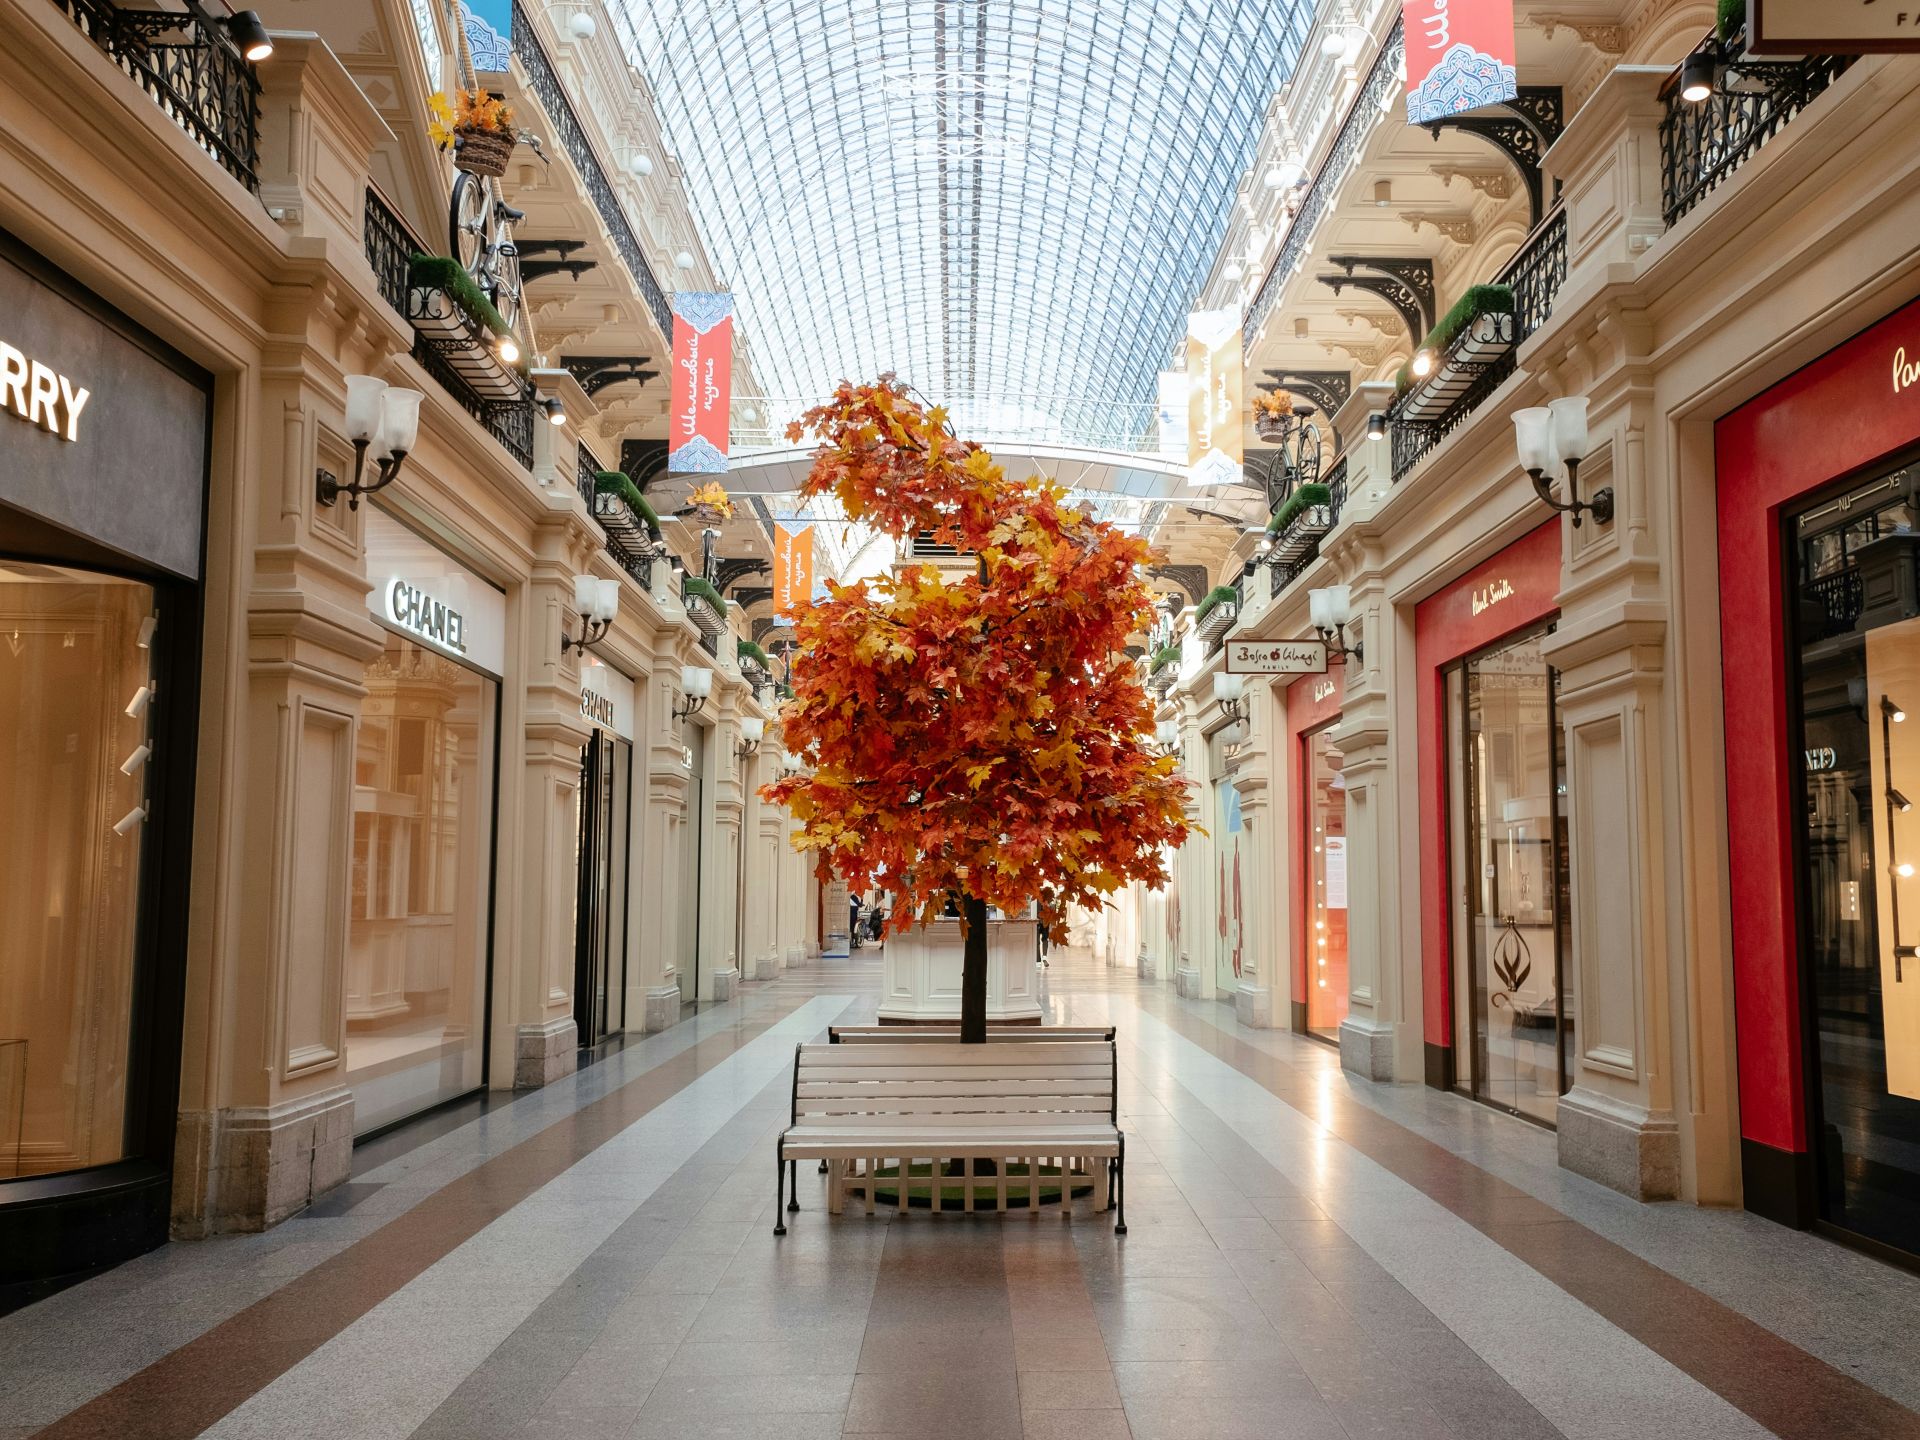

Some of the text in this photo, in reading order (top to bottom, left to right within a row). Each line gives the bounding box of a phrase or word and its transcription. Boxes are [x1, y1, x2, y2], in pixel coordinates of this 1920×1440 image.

[0, 340, 90, 442] RRY
[680, 333, 699, 435] Шелковый
[704, 358, 720, 411] путь
[391, 580, 467, 654] CHANEL
[580, 687, 615, 729] CHANEL
